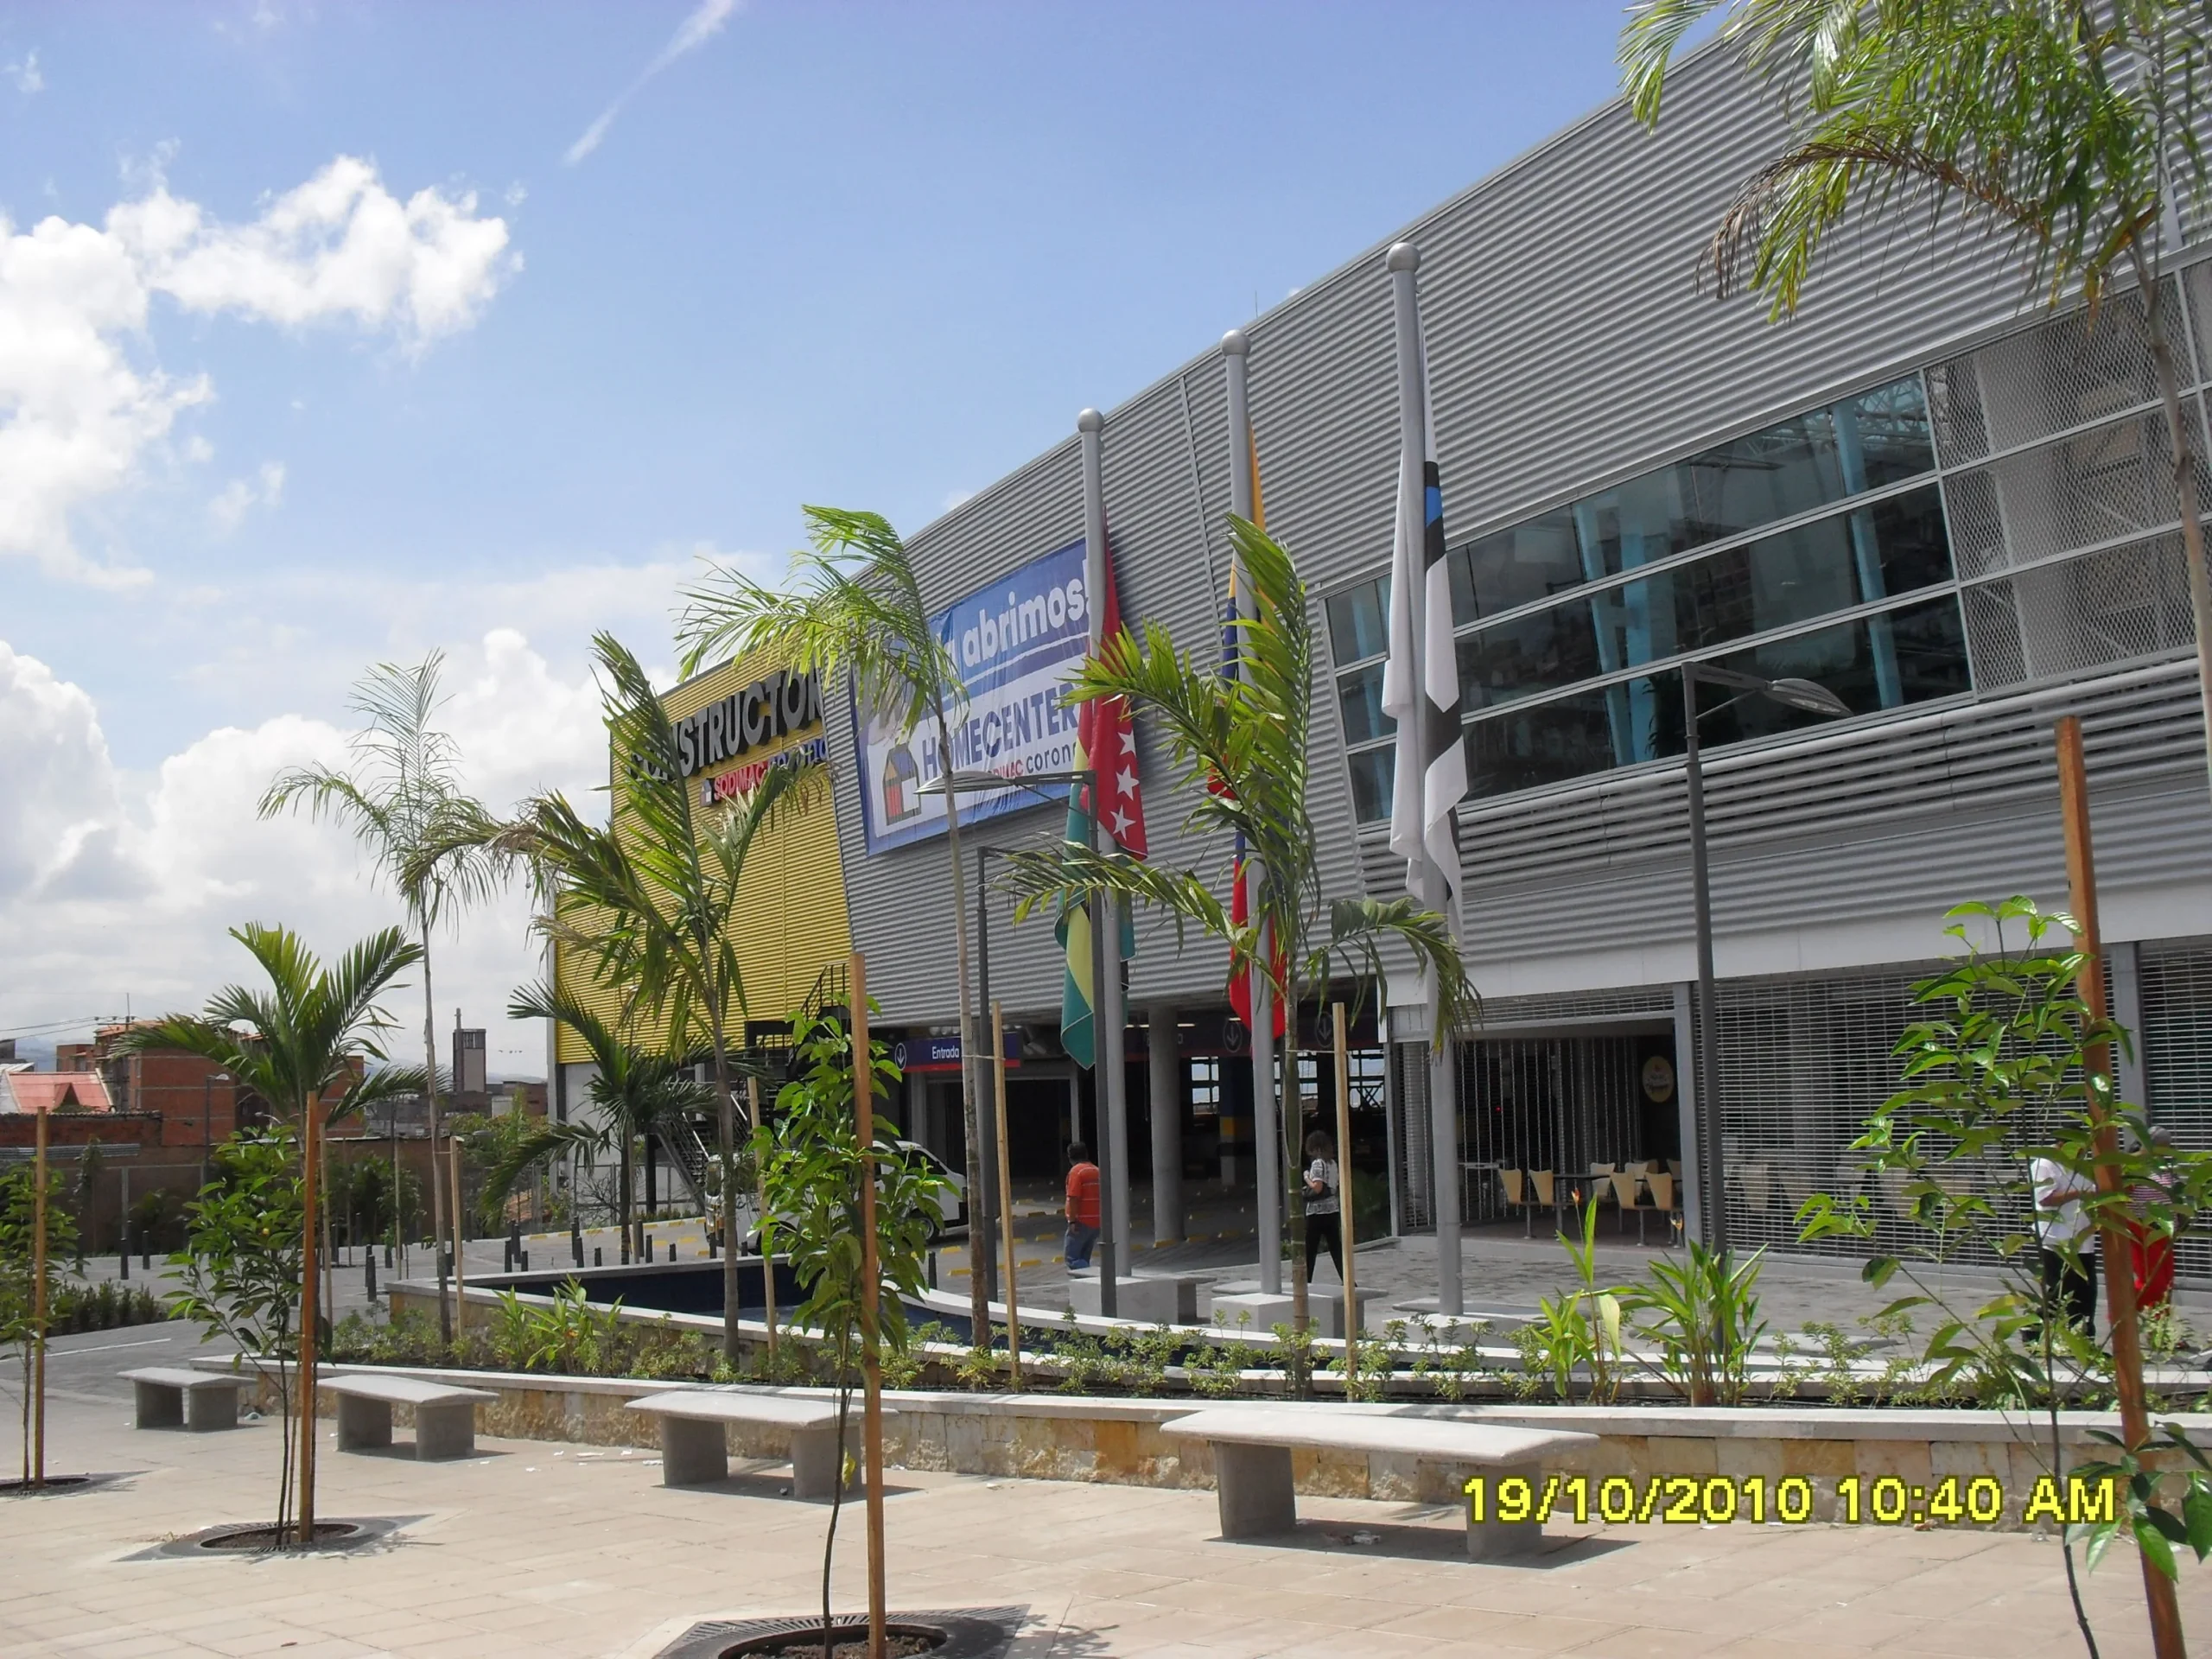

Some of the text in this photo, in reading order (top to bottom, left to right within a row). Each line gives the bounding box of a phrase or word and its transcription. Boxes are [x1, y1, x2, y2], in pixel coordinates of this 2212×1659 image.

[921, 681, 1079, 782] HOMECENTER
[1026, 741, 1077, 774] coron
[931, 1045, 960, 1059] Entrada
